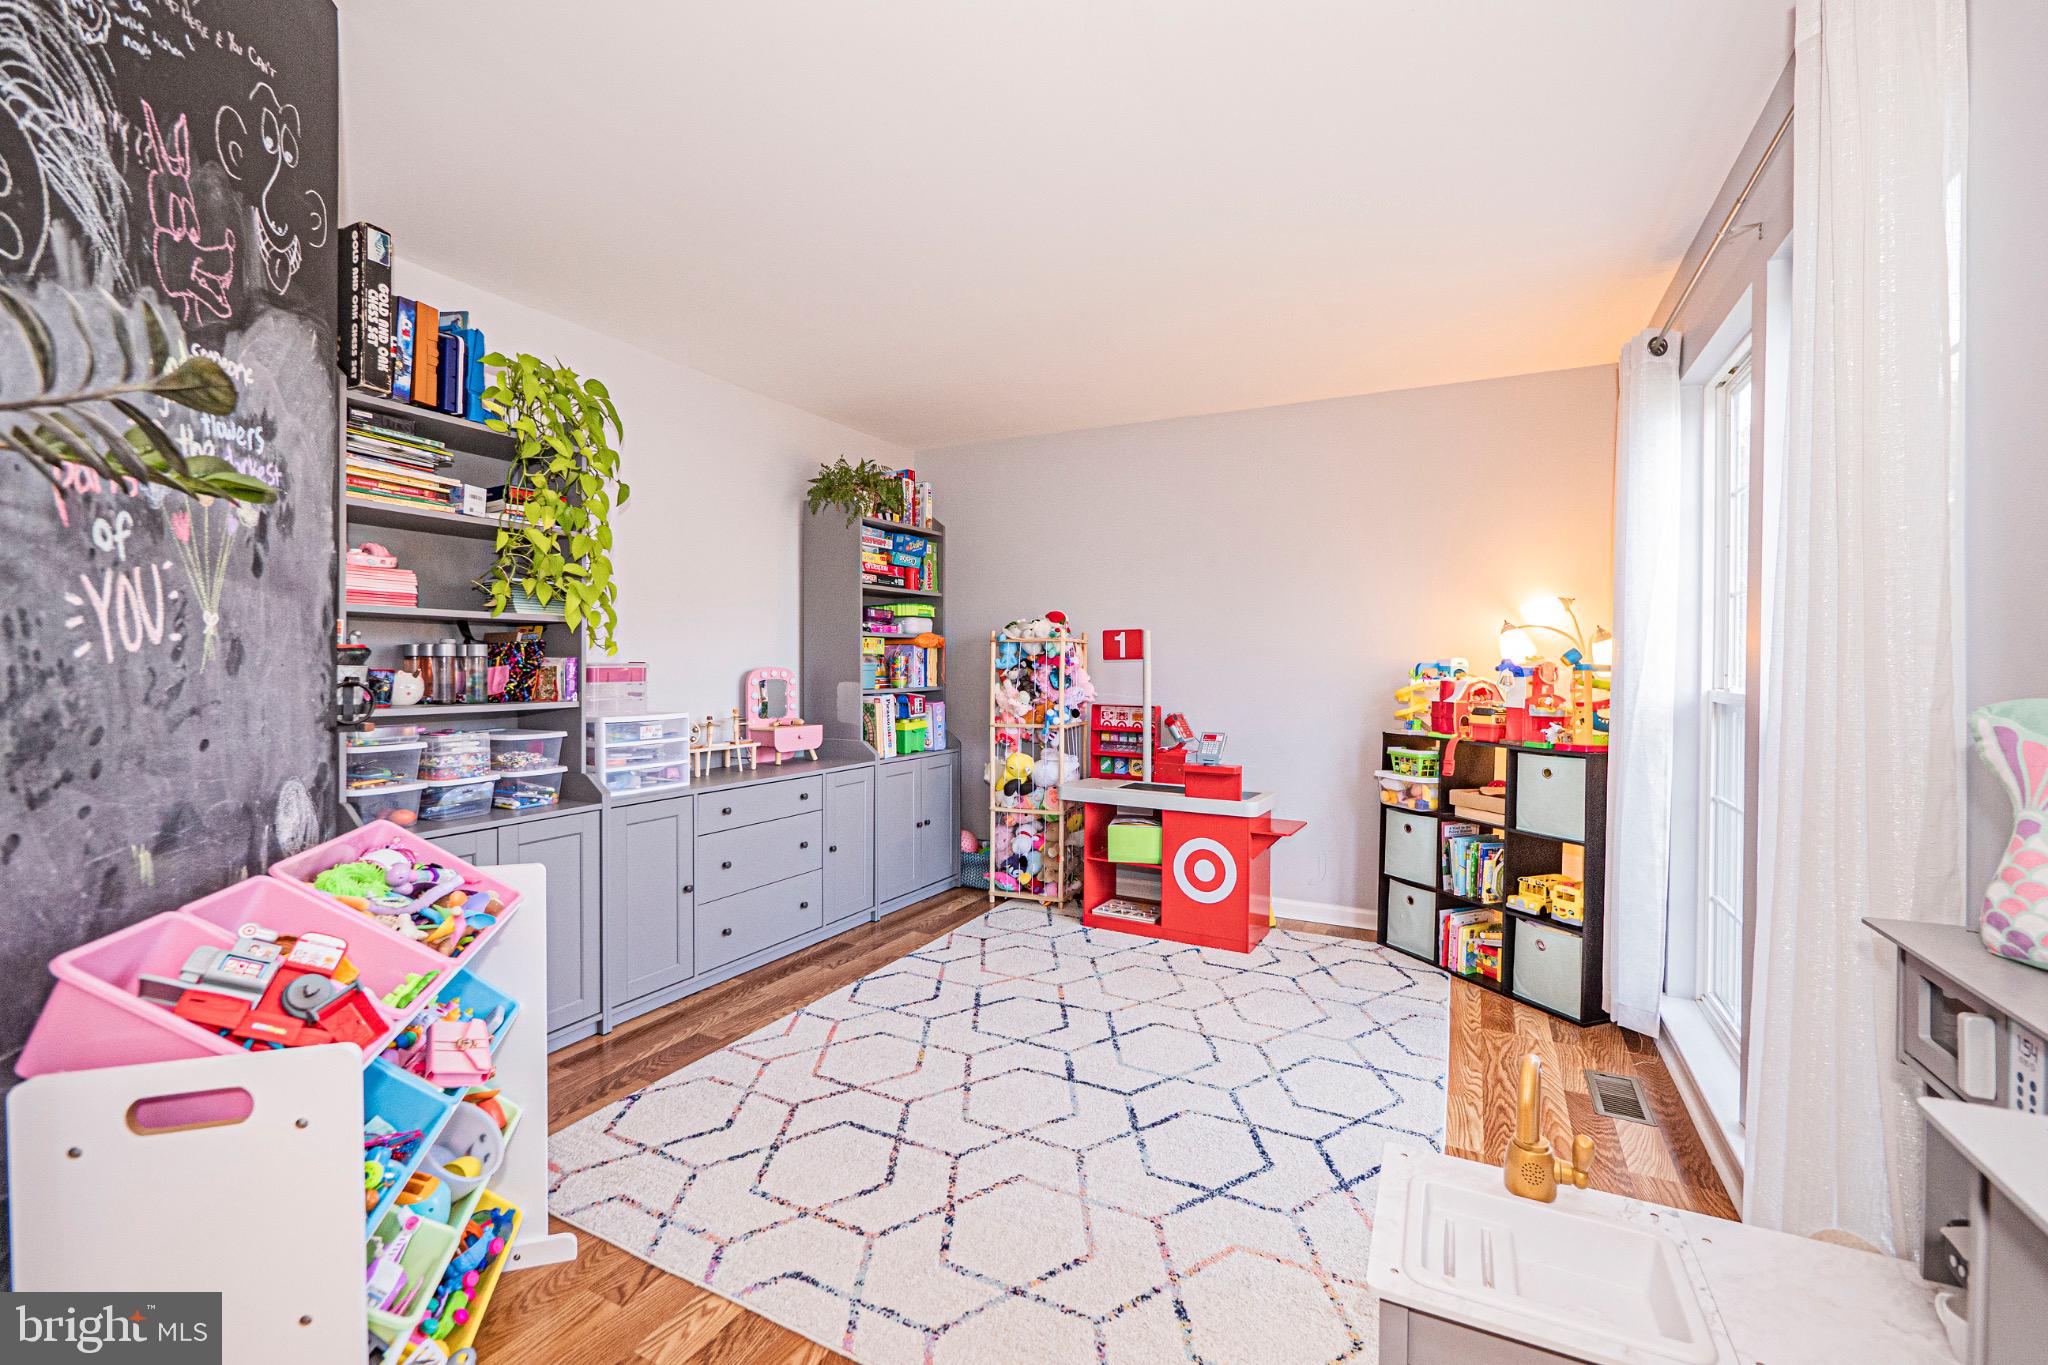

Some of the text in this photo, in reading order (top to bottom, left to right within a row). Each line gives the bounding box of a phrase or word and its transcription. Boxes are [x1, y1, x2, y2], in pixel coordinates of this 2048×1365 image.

[351, 230, 359, 264] GOLD
[351, 294, 359, 320] OAK
[367, 288, 379, 347] CHESS SET
[377, 283, 390, 372] GOLD AND OAK
[92, 510, 135, 562] of
[80, 563, 165, 664] YOU
[1114, 631, 1126, 659] 1
